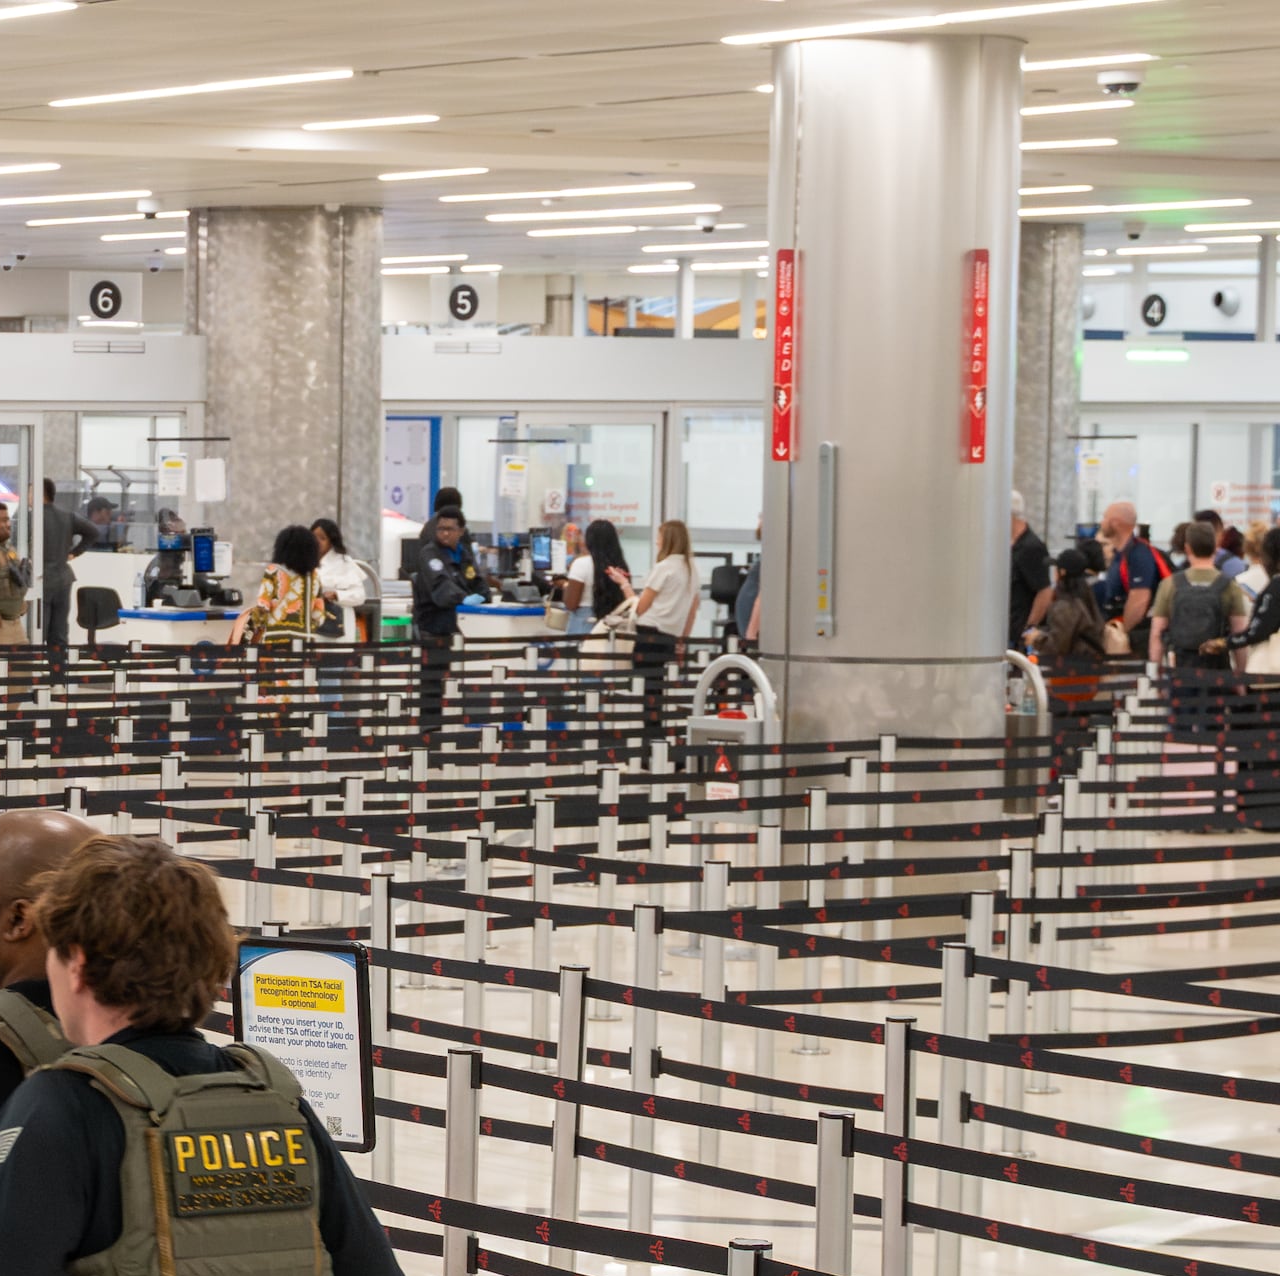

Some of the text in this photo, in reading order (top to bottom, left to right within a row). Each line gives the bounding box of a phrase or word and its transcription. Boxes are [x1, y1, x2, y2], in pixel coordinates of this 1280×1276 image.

[97, 288, 114, 313] 6
[456, 290, 472, 315] 5
[1146, 301, 1162, 322] 4
[255, 976, 300, 987] Participation
[309, 980, 322, 989] TSA
[323, 981, 342, 990] facial
[260, 987, 338, 1001] recognition technology
[288, 999, 317, 1009] optional
[257, 1014, 345, 1030] Before you insert your ID,
[248, 1024, 354, 1041] advise the TSA officer if you do
[255, 1035, 348, 1050] not want your photo taken.
[280, 1056, 348, 1070] hoto is deleted after
[305, 1069, 334, 1081] identity.
[308, 1089, 323, 1098] lose
[324, 1091, 340, 1100] your
[173, 1128, 308, 1173] POLICE
